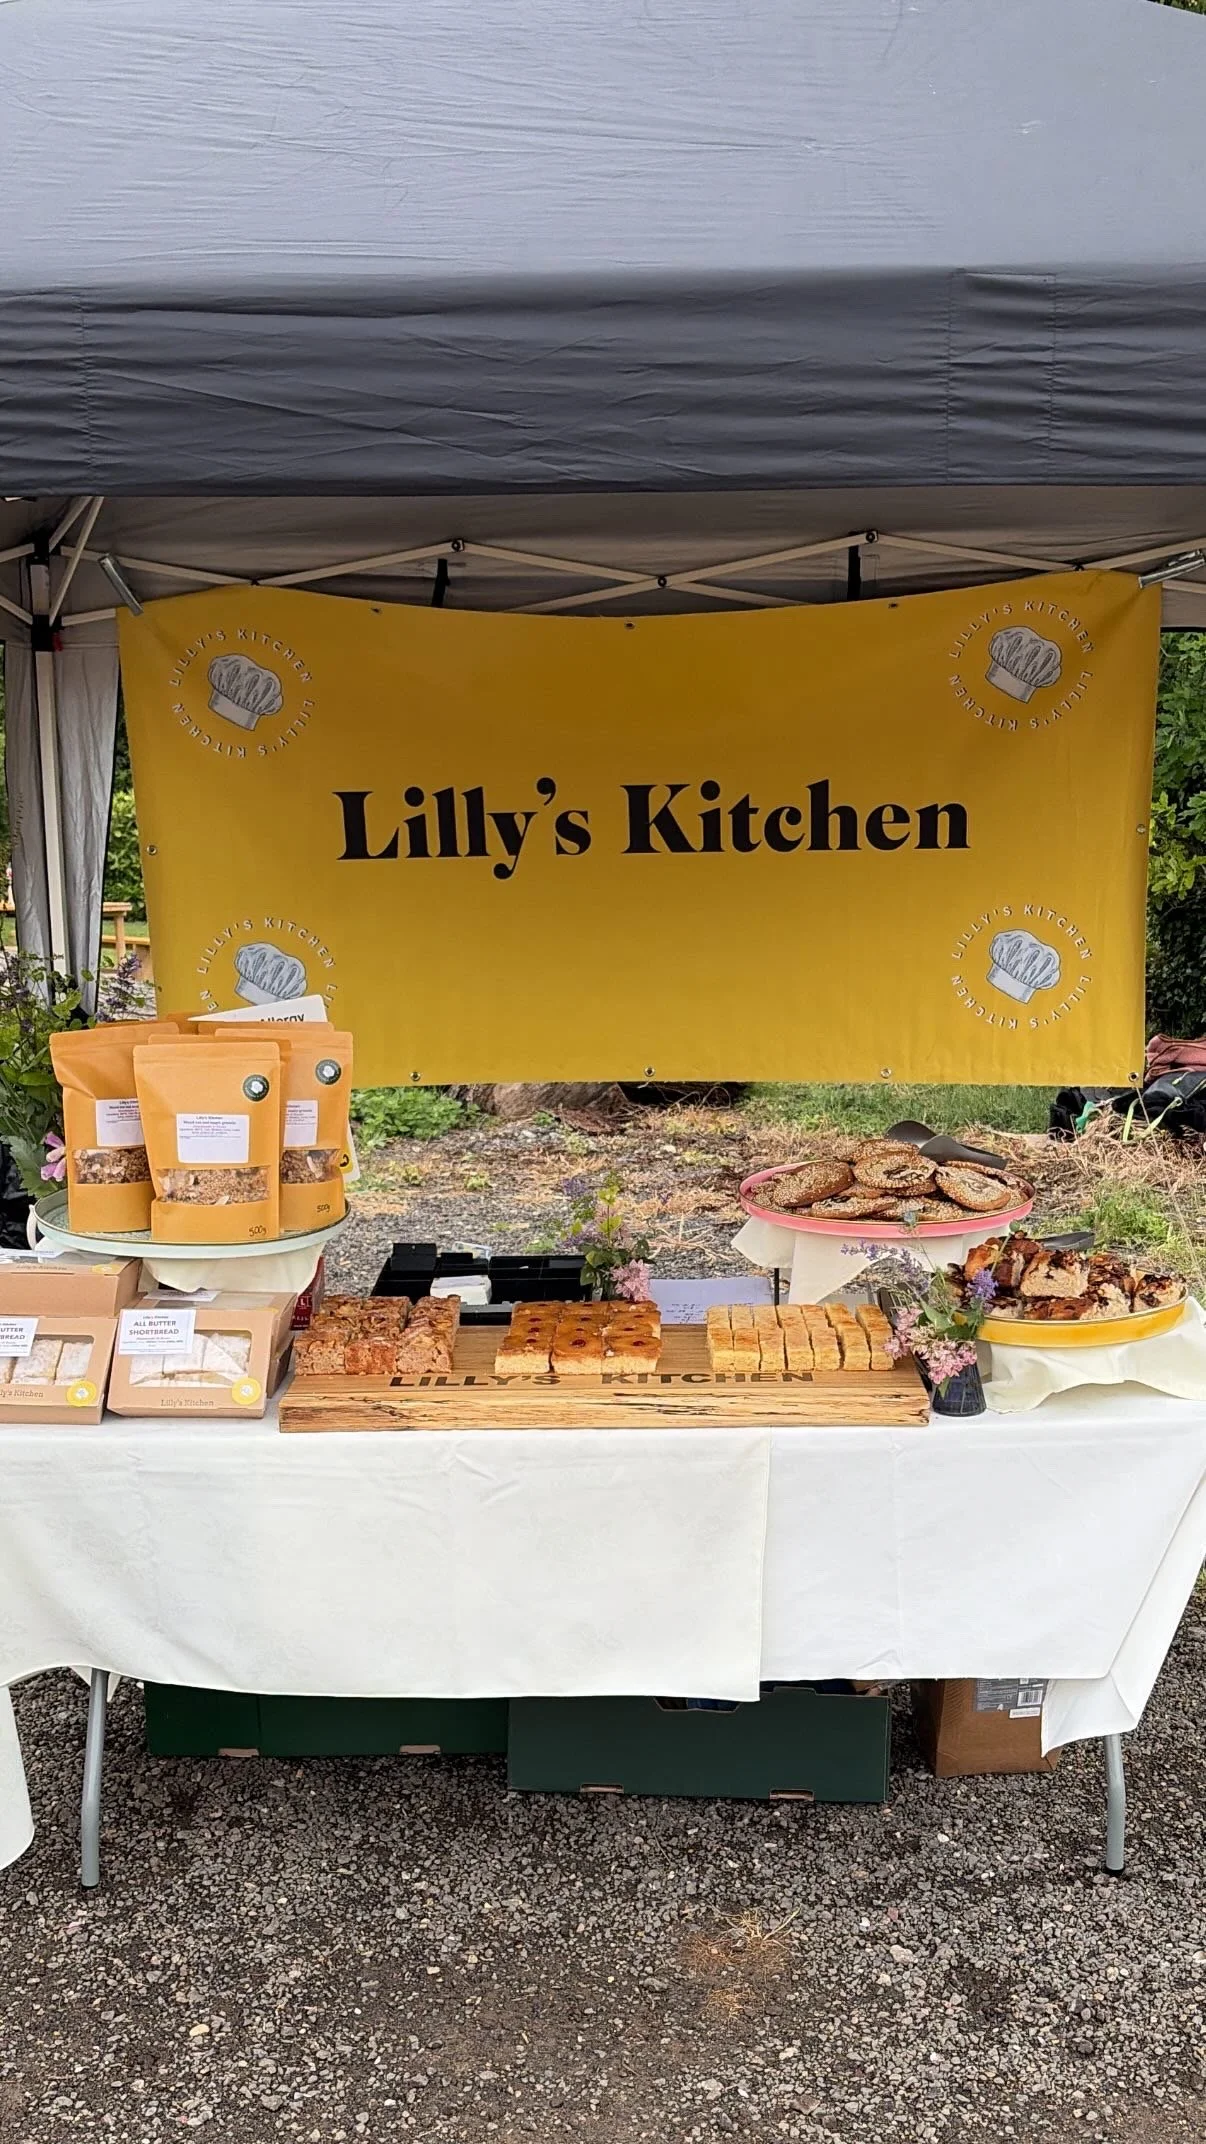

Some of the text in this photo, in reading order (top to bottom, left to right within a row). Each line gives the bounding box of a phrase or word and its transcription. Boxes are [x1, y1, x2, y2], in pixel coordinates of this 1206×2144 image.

[170, 628, 312, 687] LILLY'S KITCHEN
[949, 601, 1094, 658] LILLY'S KITCHEN
[172, 699, 315, 758] LILLY'S KITCHEN
[949, 671, 1093, 730] LILLY'S KITCHEN
[332, 777, 971, 880] Lilly's Kitchen
[197, 917, 336, 974] LILLY'S KITCHEN
[951, 904, 1093, 959] LILLY'S KITCHEN
[951, 975, 1092, 1029] LILLY'S KITCHEN
[248, 1225, 267, 1237] 500g
[317, 1203, 331, 1213] 500g
[389, 1372, 813, 1387] LILLY'S KITCHEN
